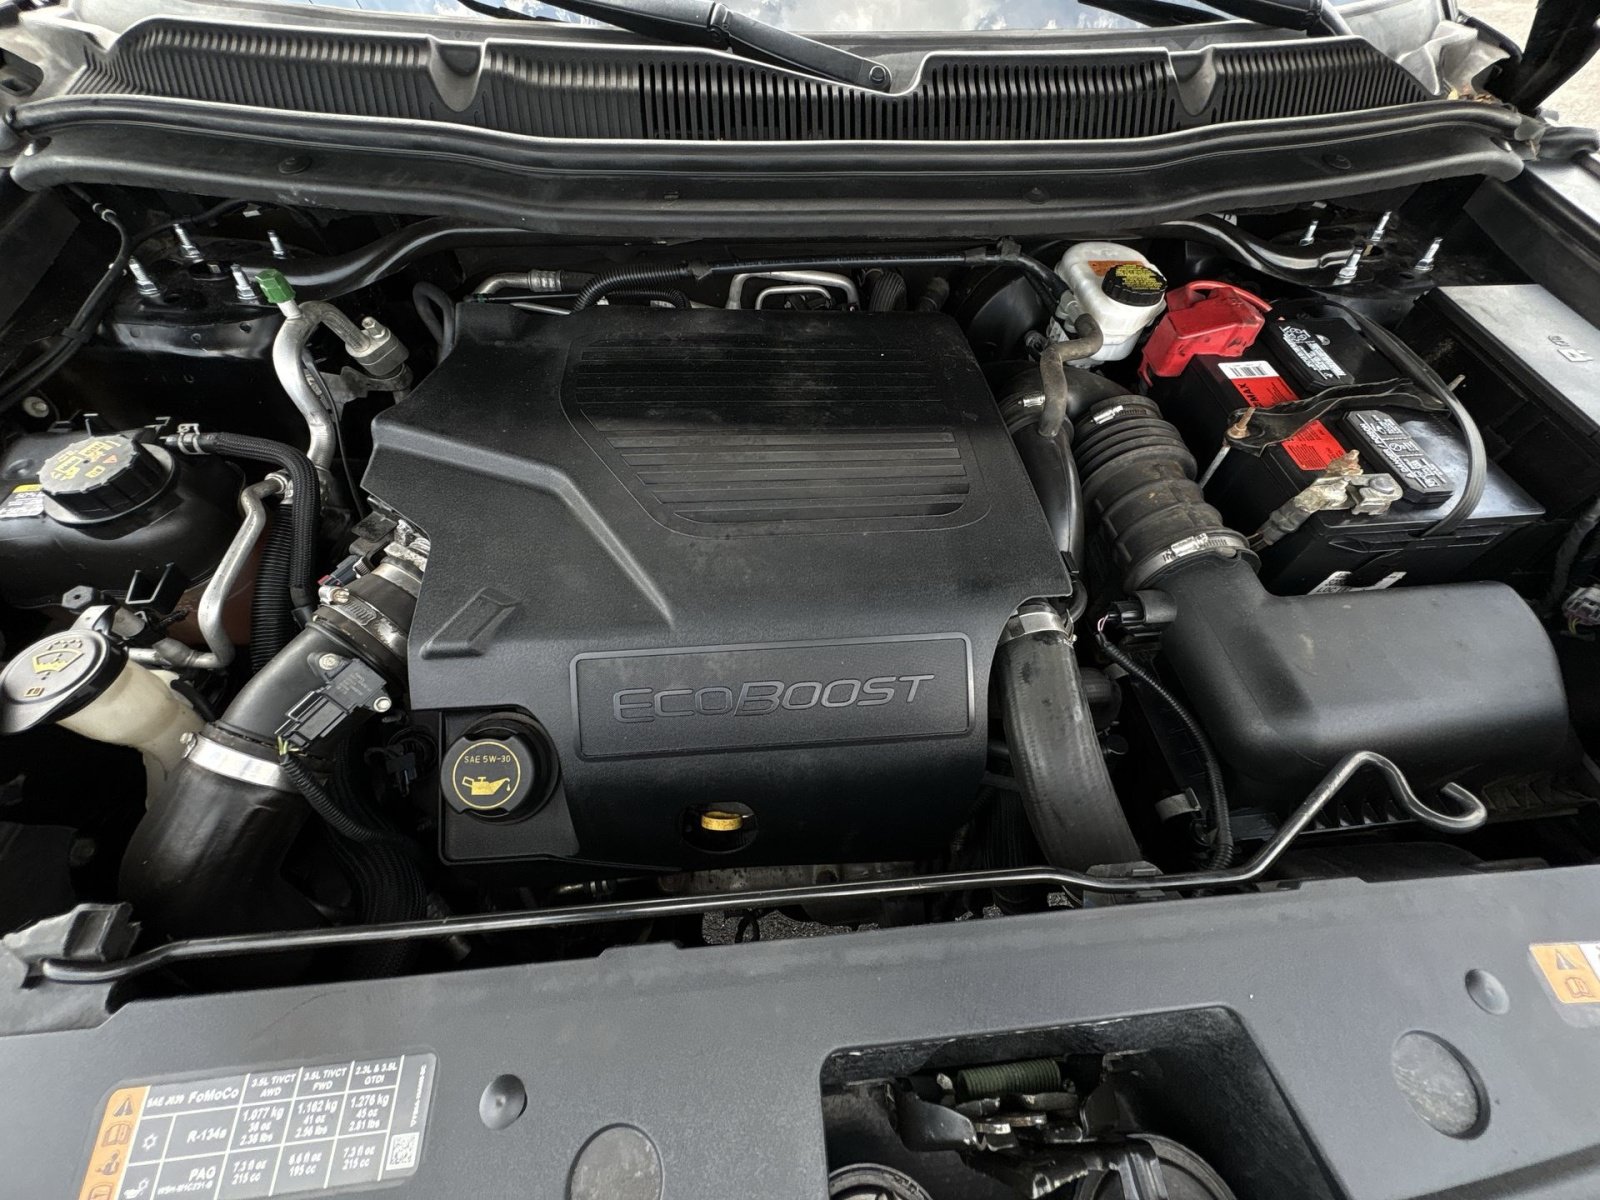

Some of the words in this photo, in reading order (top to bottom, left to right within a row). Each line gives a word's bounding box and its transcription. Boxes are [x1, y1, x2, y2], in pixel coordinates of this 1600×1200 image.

[612, 674, 935, 724] ECOBOOST
[464, 755, 480, 764] SAE
[482, 755, 511, 764] 5W-30
[260, 1087, 282, 1098] AWD
[312, 1081, 333, 1092] FWD
[188, 1087, 239, 1104] FoMoCo
[376, 1093, 390, 1108] kg
[298, 1099, 324, 1114] 1.162
[324, 1098, 338, 1113] kg
[242, 1106, 270, 1121] 1.077
[270, 1106, 284, 1120] kg
[315, 1114, 327, 1124] oz
[367, 1108, 379, 1118] oz
[260, 1121, 272, 1131] oz
[187, 1126, 227, 1143] R-134a
[305, 1164, 317, 1175] cc
[342, 1159, 358, 1170] 215
[358, 1158, 371, 1168] cc
[189, 1165, 216, 1182] PAG
[232, 1172, 249, 1185] 215
[249, 1172, 261, 1182] cc
